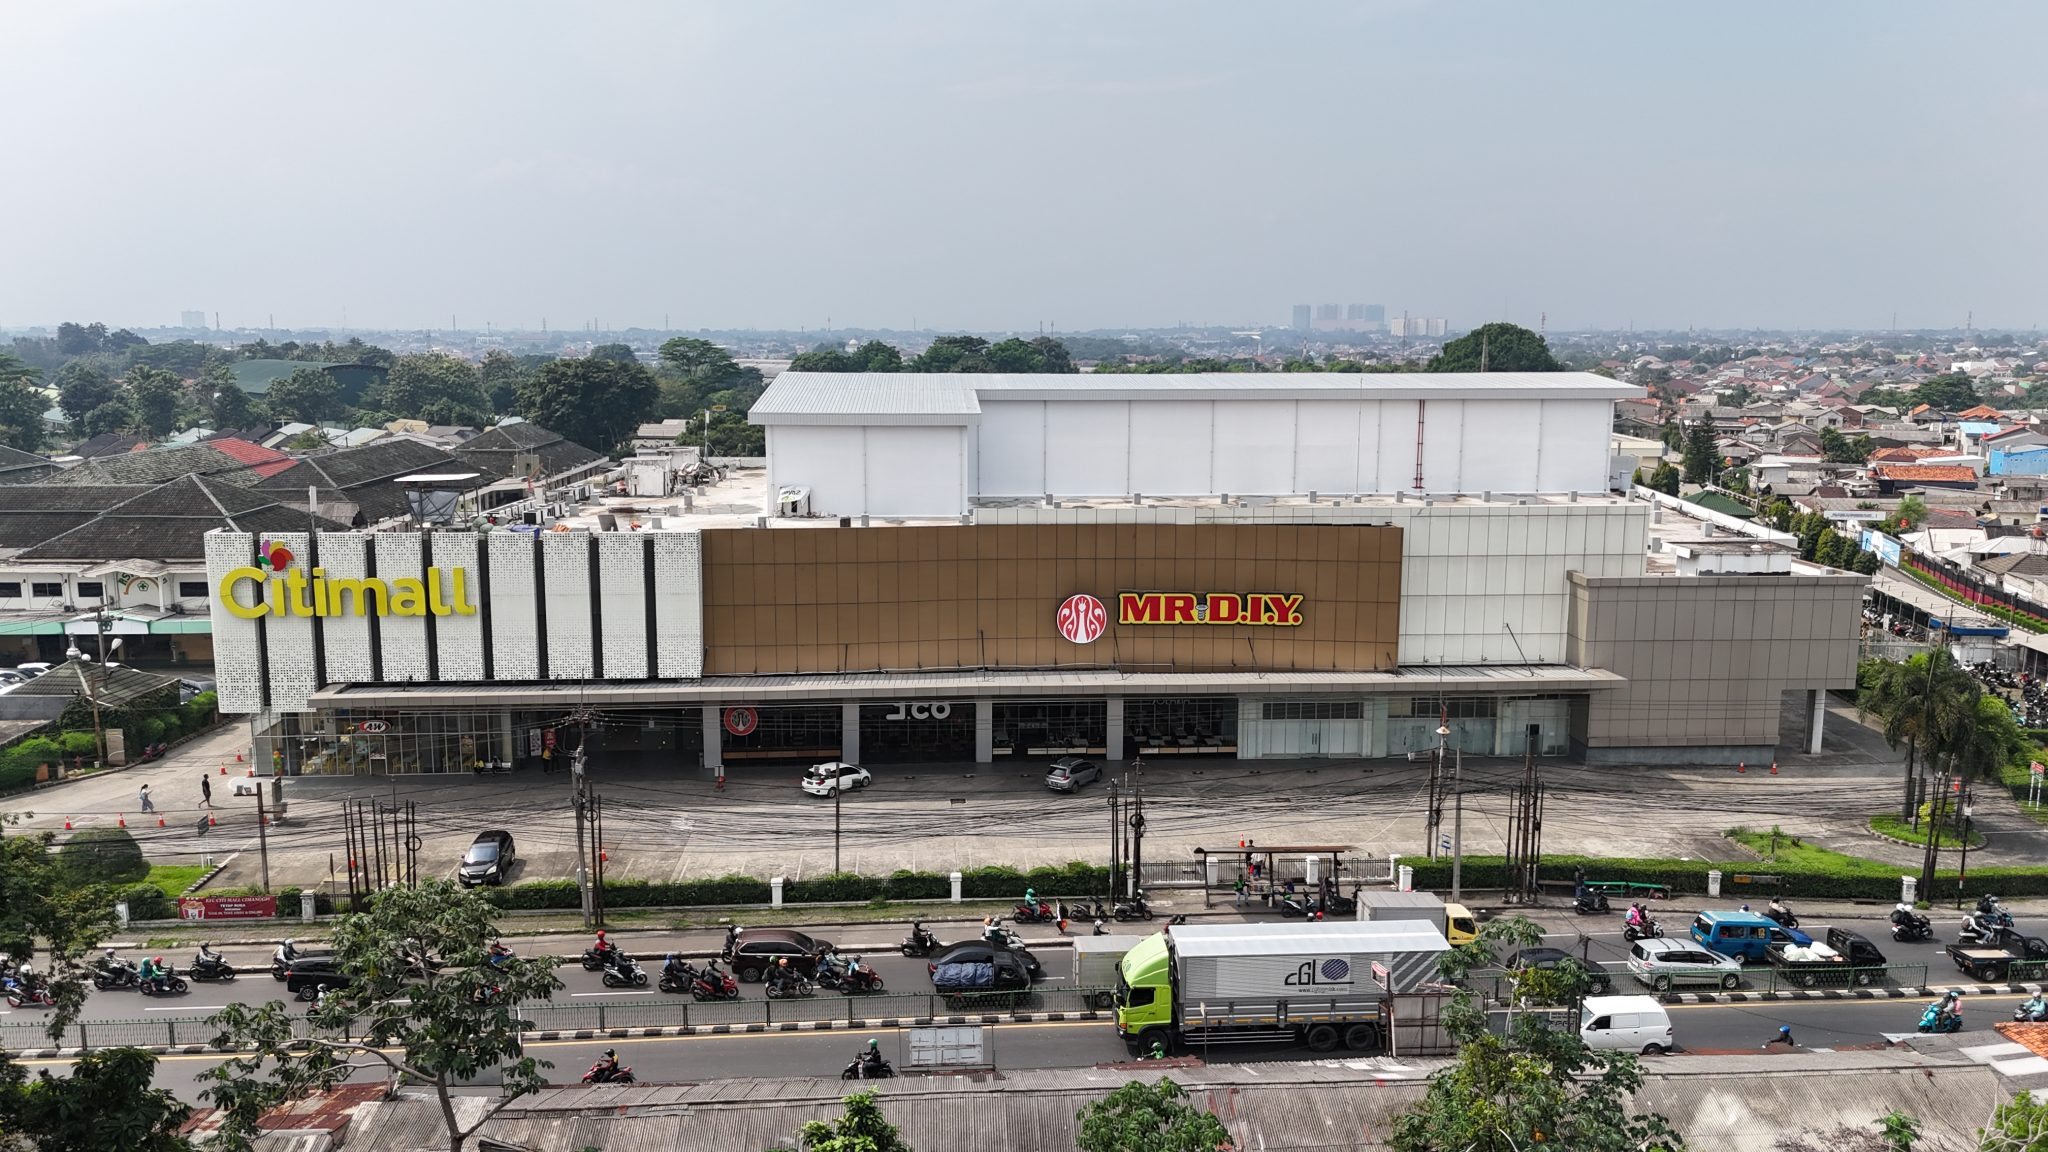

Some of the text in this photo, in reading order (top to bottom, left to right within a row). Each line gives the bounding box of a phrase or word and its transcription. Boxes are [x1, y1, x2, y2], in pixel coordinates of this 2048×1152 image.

[219, 566, 477, 619] Citimall
[1119, 593, 1197, 624] MR
[885, 702, 951, 720] J.CO
